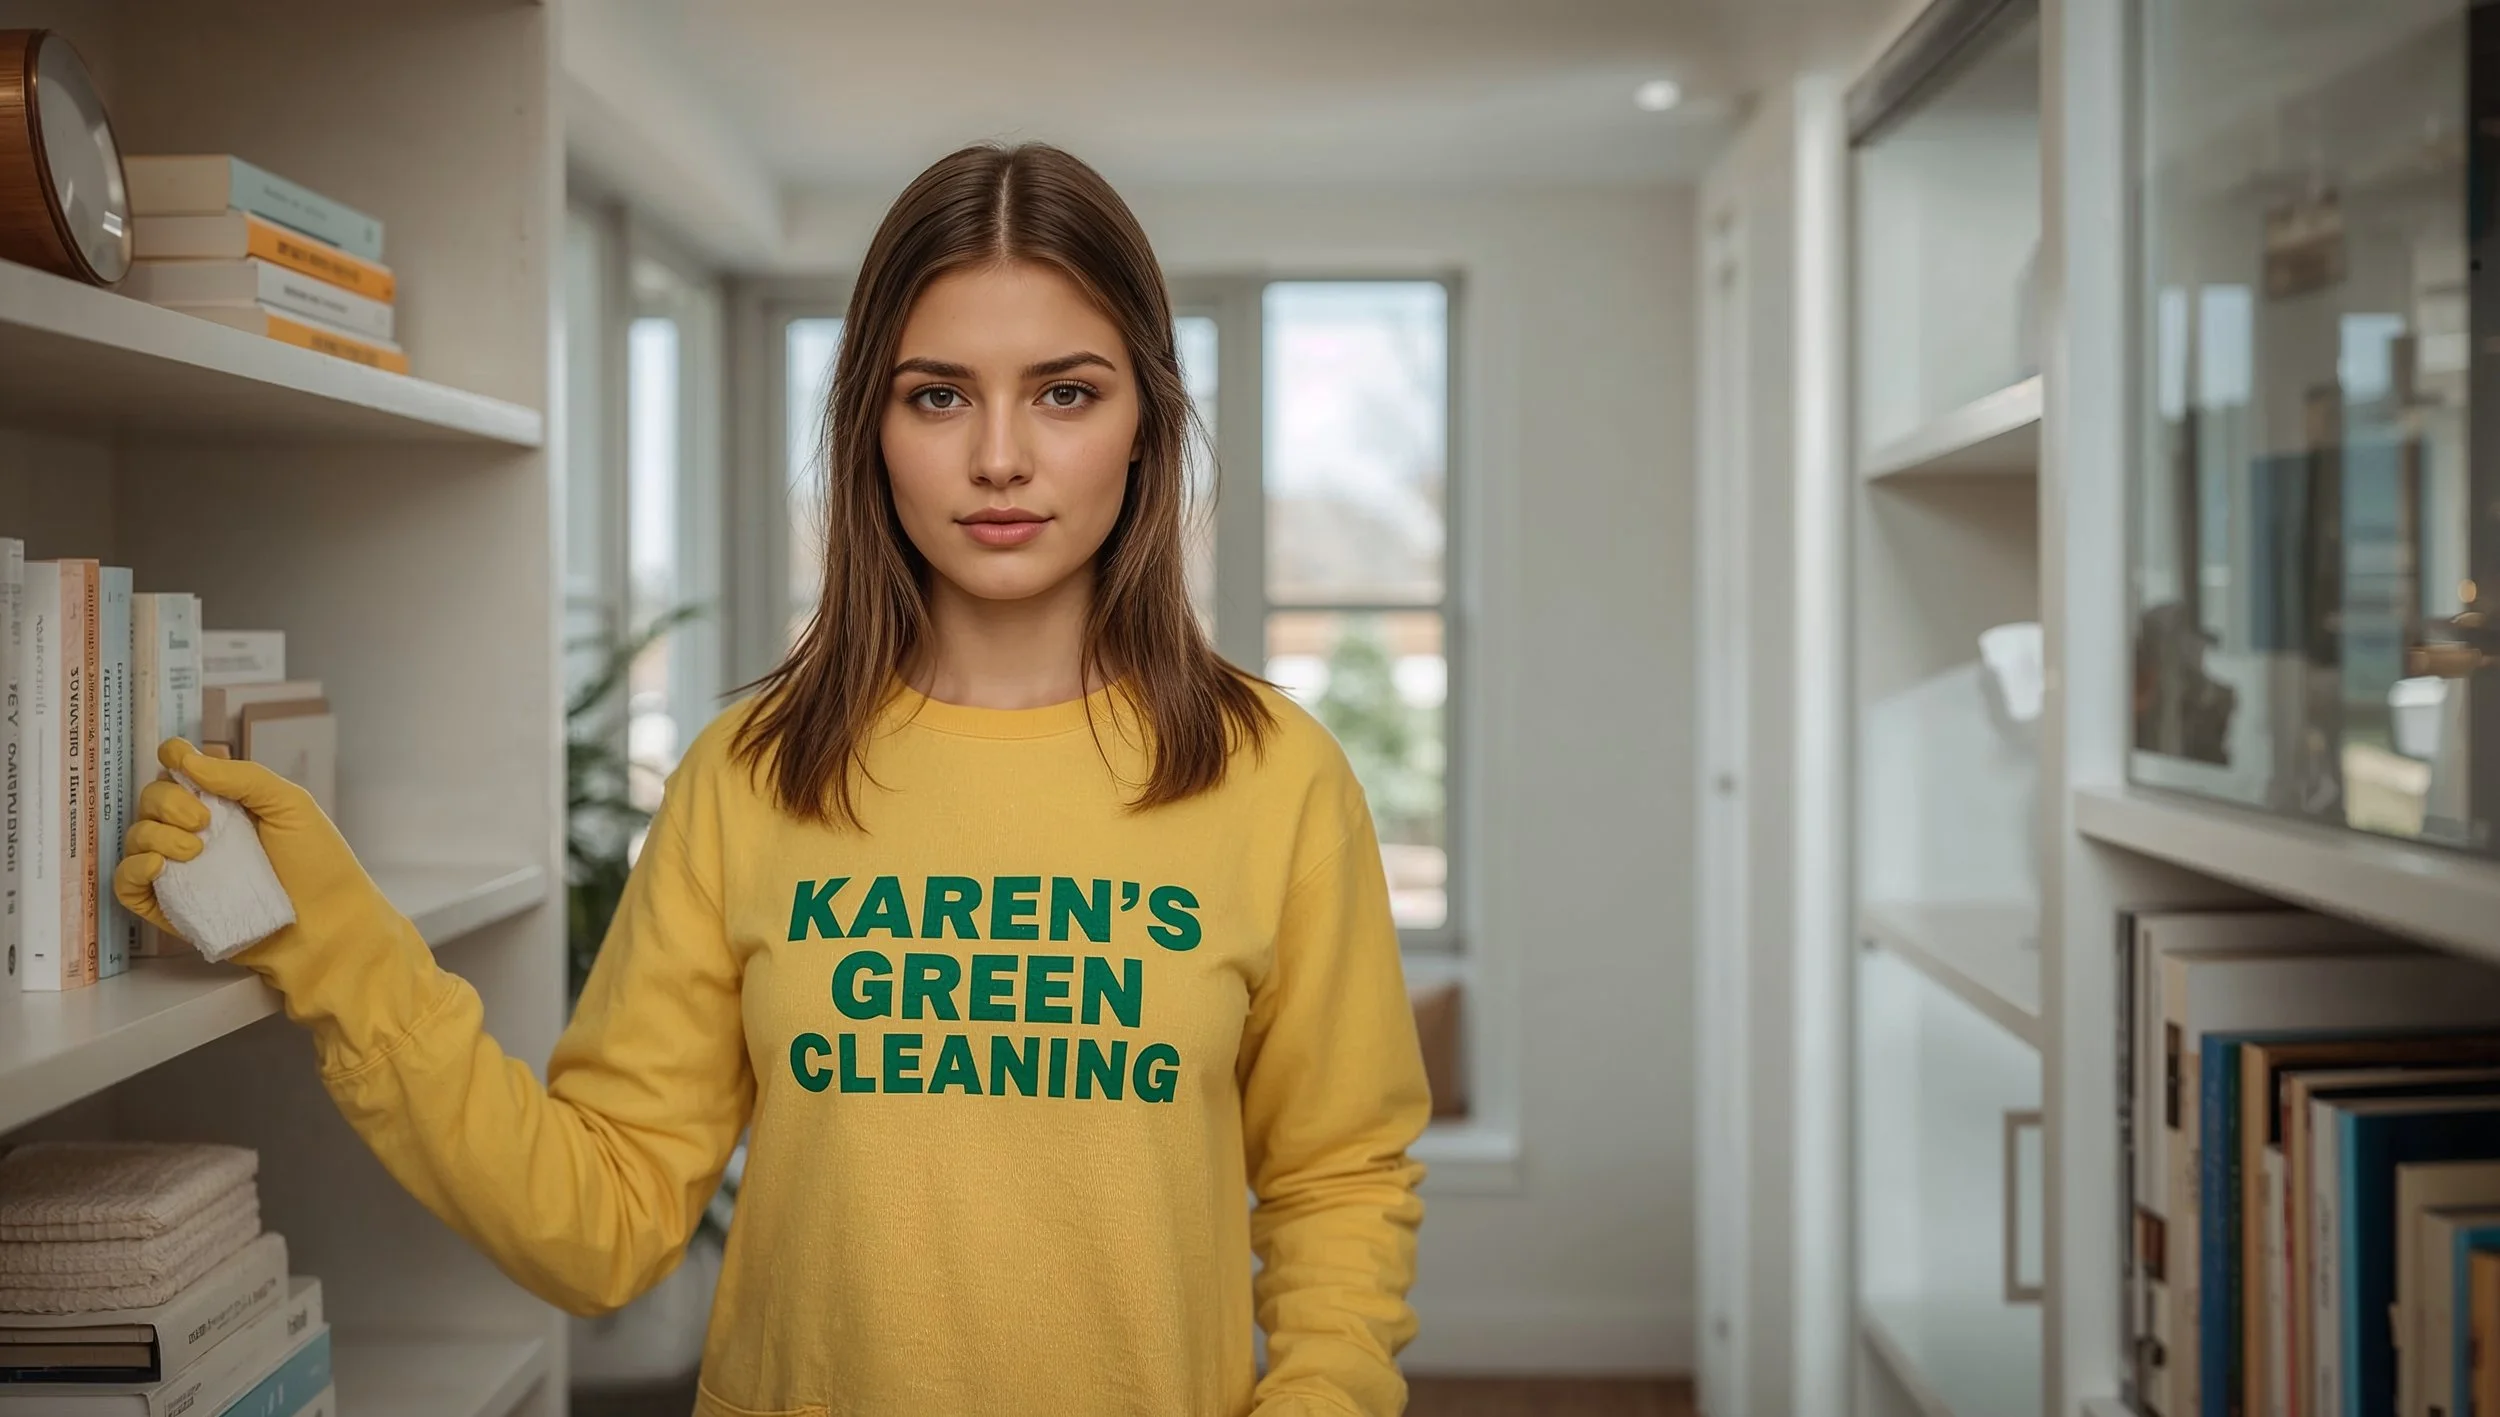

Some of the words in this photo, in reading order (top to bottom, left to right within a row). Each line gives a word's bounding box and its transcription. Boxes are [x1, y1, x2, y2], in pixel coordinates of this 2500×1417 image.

[788, 876, 1202, 951] KAREN'S
[832, 951, 1142, 1028] GREEN
[790, 1033, 1180, 1103] CLEANING
